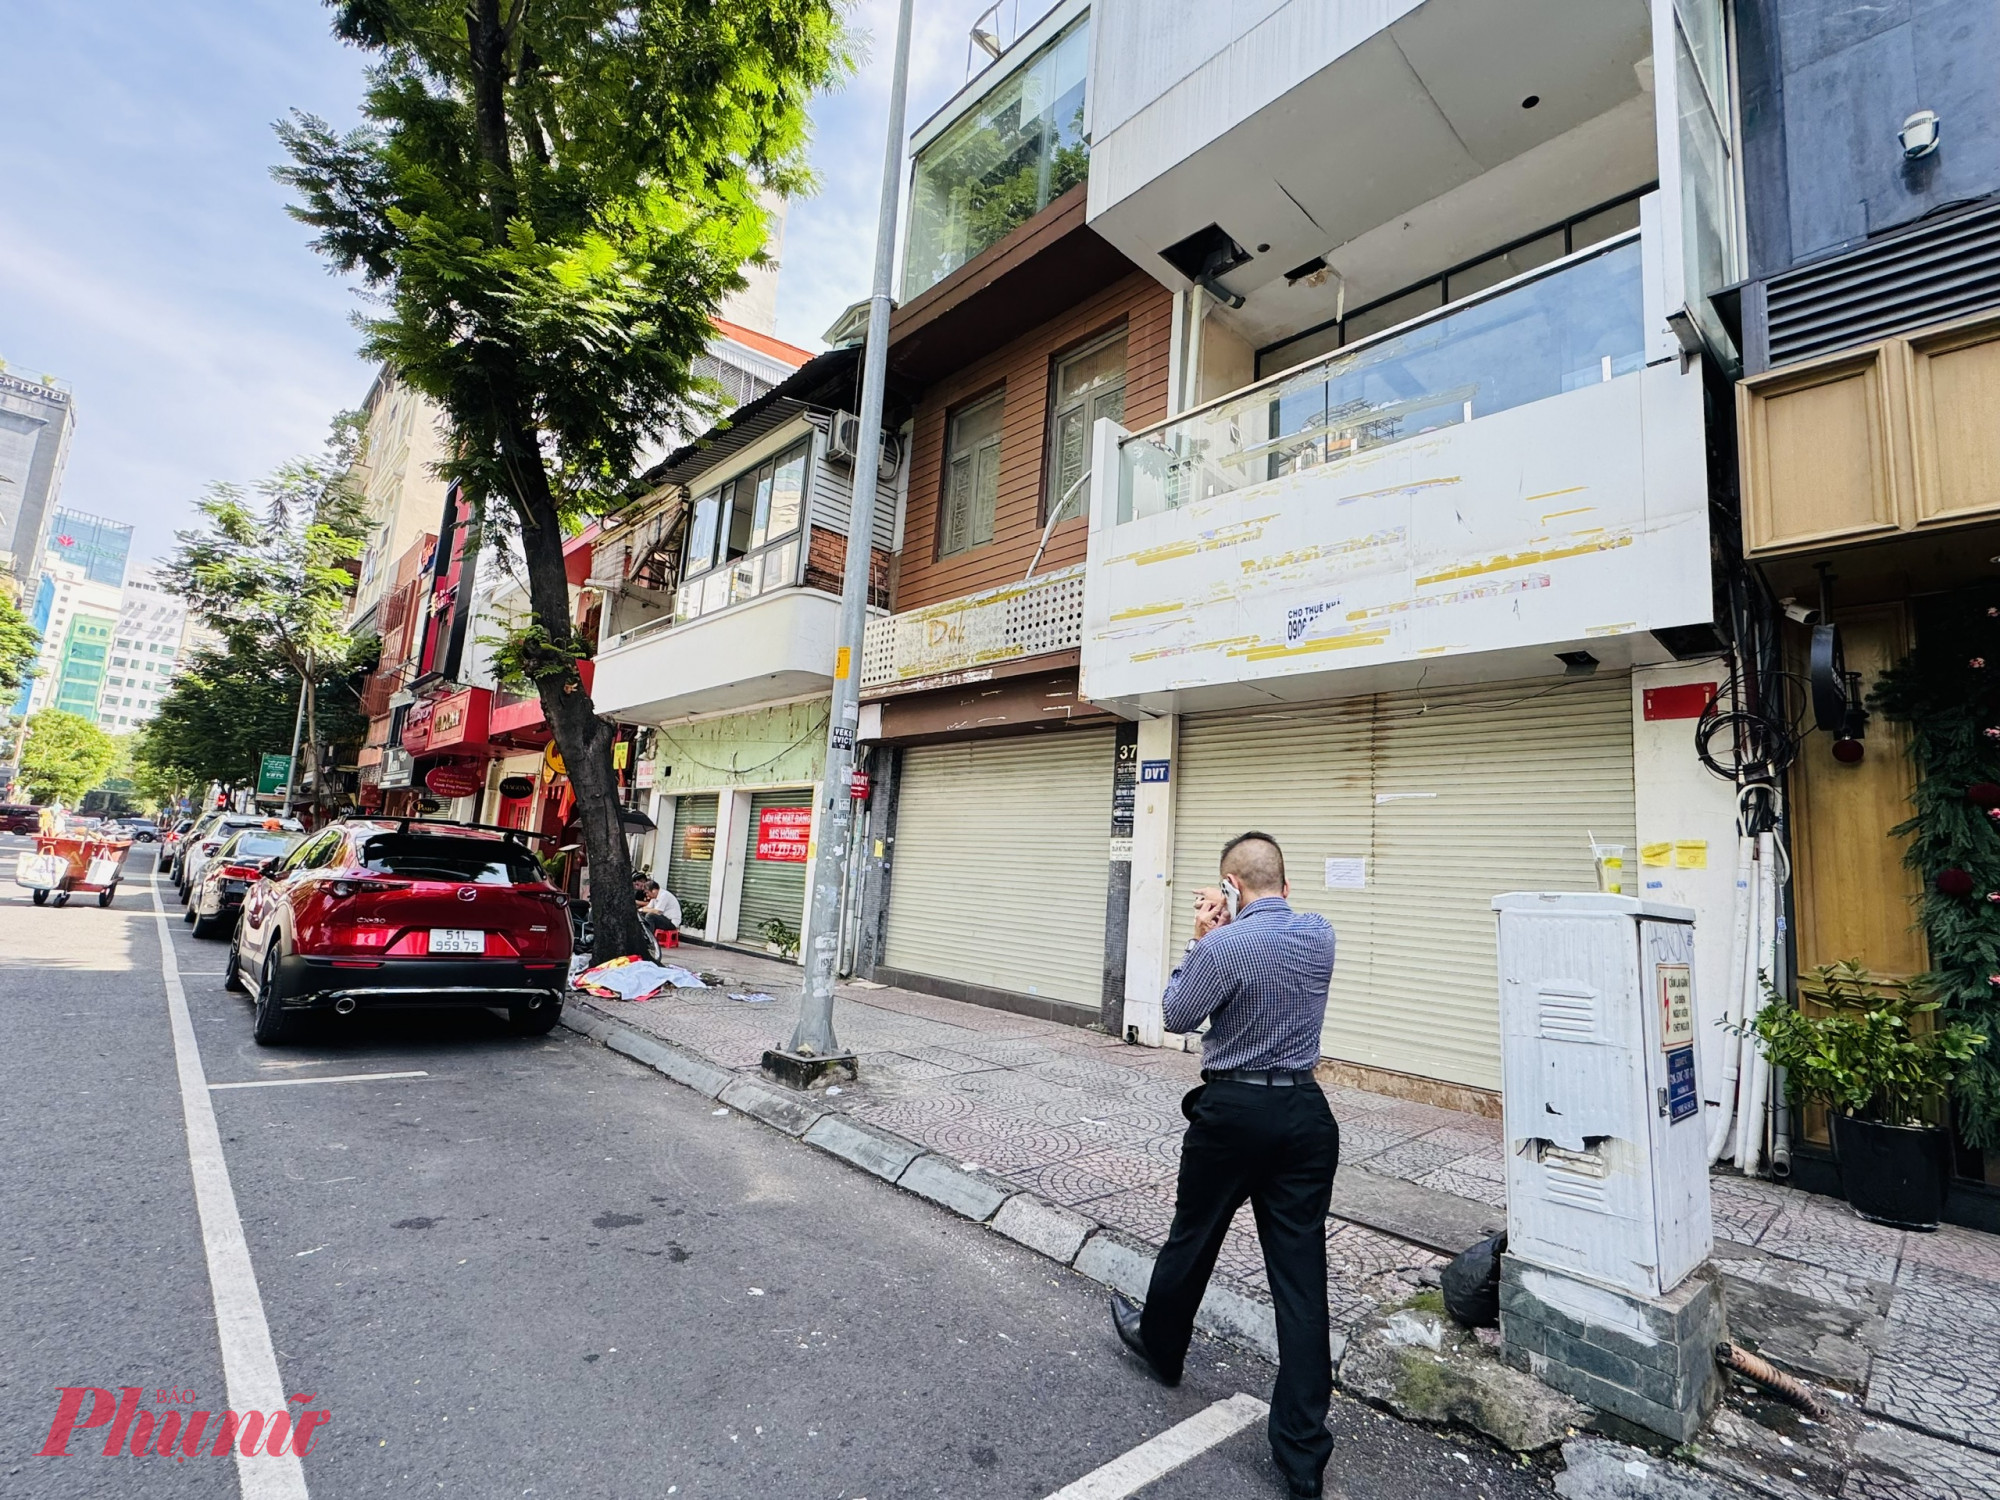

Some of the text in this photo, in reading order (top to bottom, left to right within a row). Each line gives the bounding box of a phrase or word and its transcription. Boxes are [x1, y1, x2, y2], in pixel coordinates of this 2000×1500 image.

[20, 381, 66, 401] HOTEL
[1288, 608, 1303, 619] CHO
[1305, 601, 1324, 616] THUÊ
[835, 728, 853, 738] VEKS
[833, 735, 853, 745] EVICT
[1120, 744, 1137, 760] 37
[1144, 767, 1166, 780] DVT
[853, 774, 869, 786] NDRY
[768, 828, 780, 840] MS
[446, 930, 469, 940] 51L
[436, 940, 479, 952] 959.75
